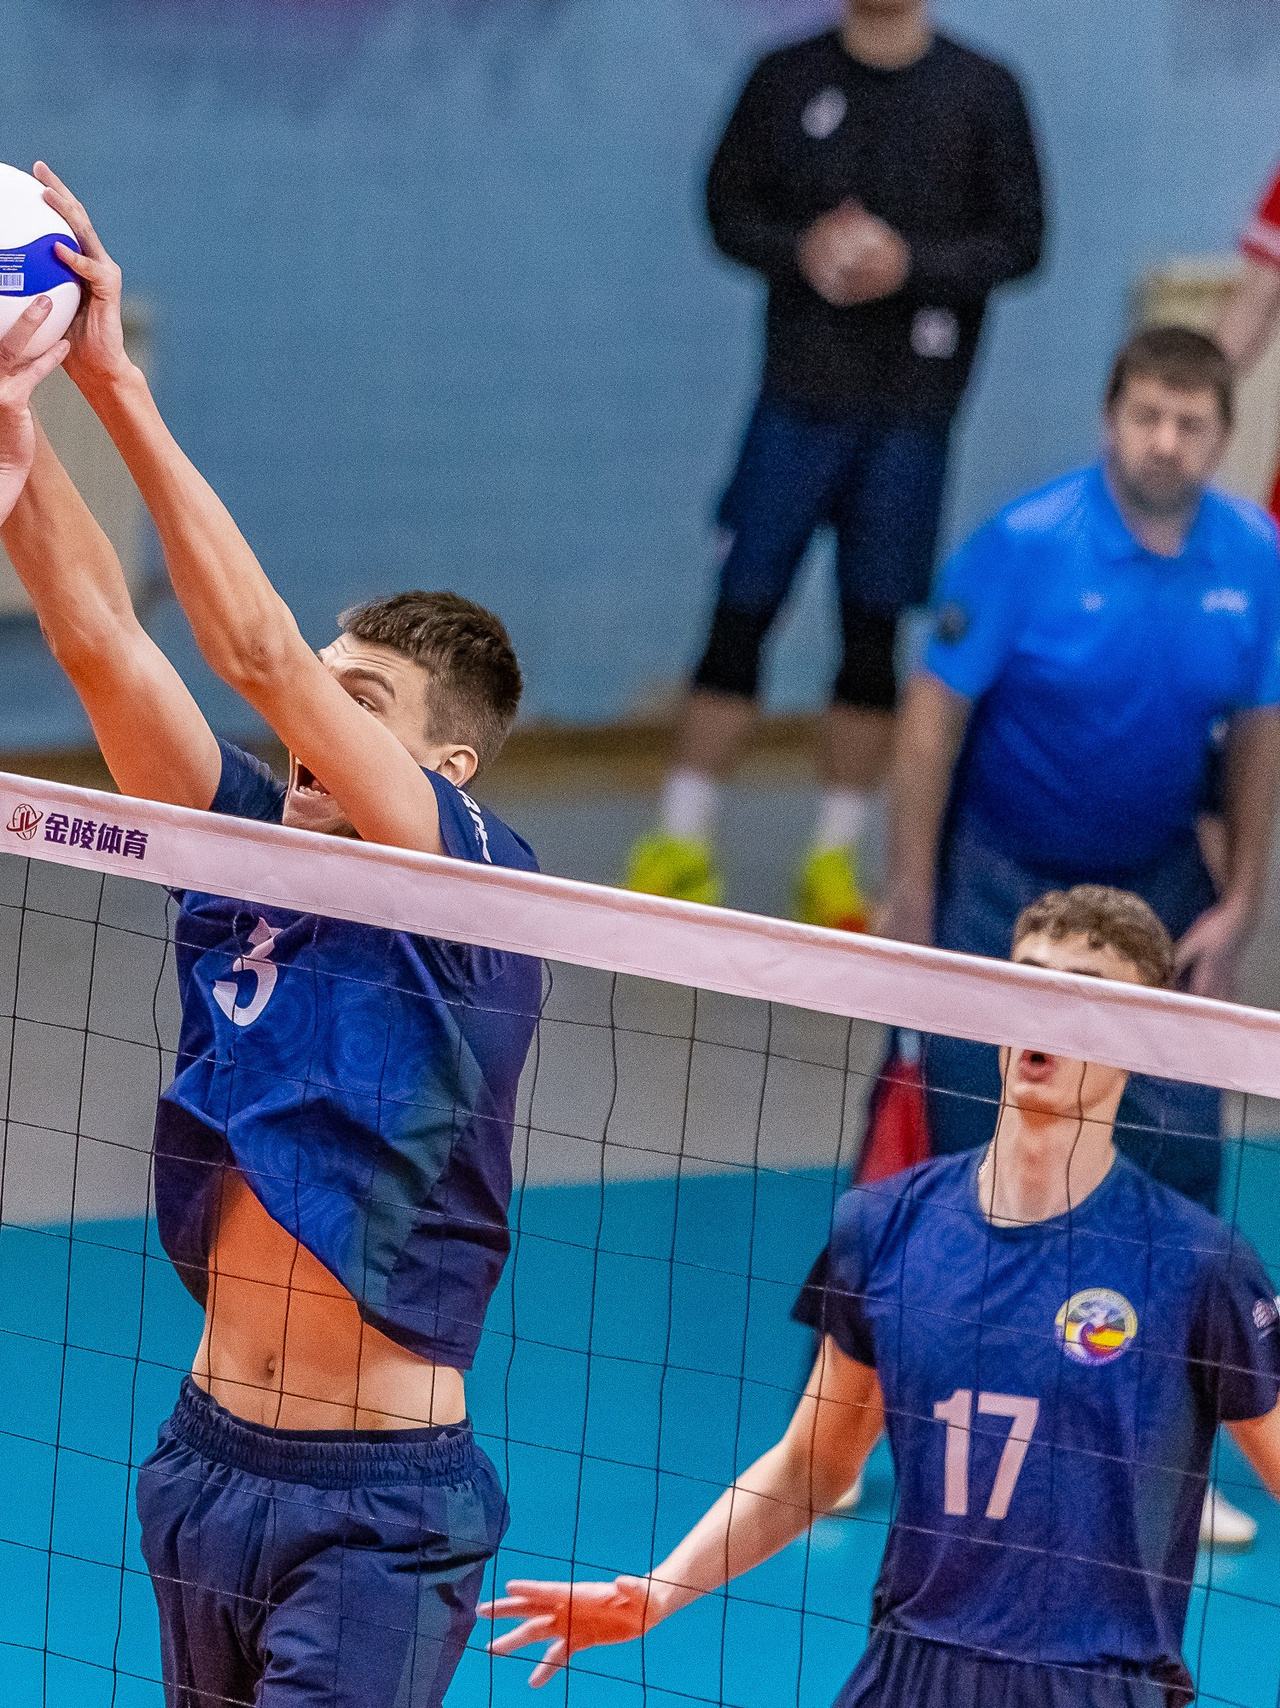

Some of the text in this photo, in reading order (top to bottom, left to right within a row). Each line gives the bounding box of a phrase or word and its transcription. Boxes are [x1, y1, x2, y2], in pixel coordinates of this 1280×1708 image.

[44, 812, 149, 861] 金陵体育
[933, 1388, 1040, 1520] 17
